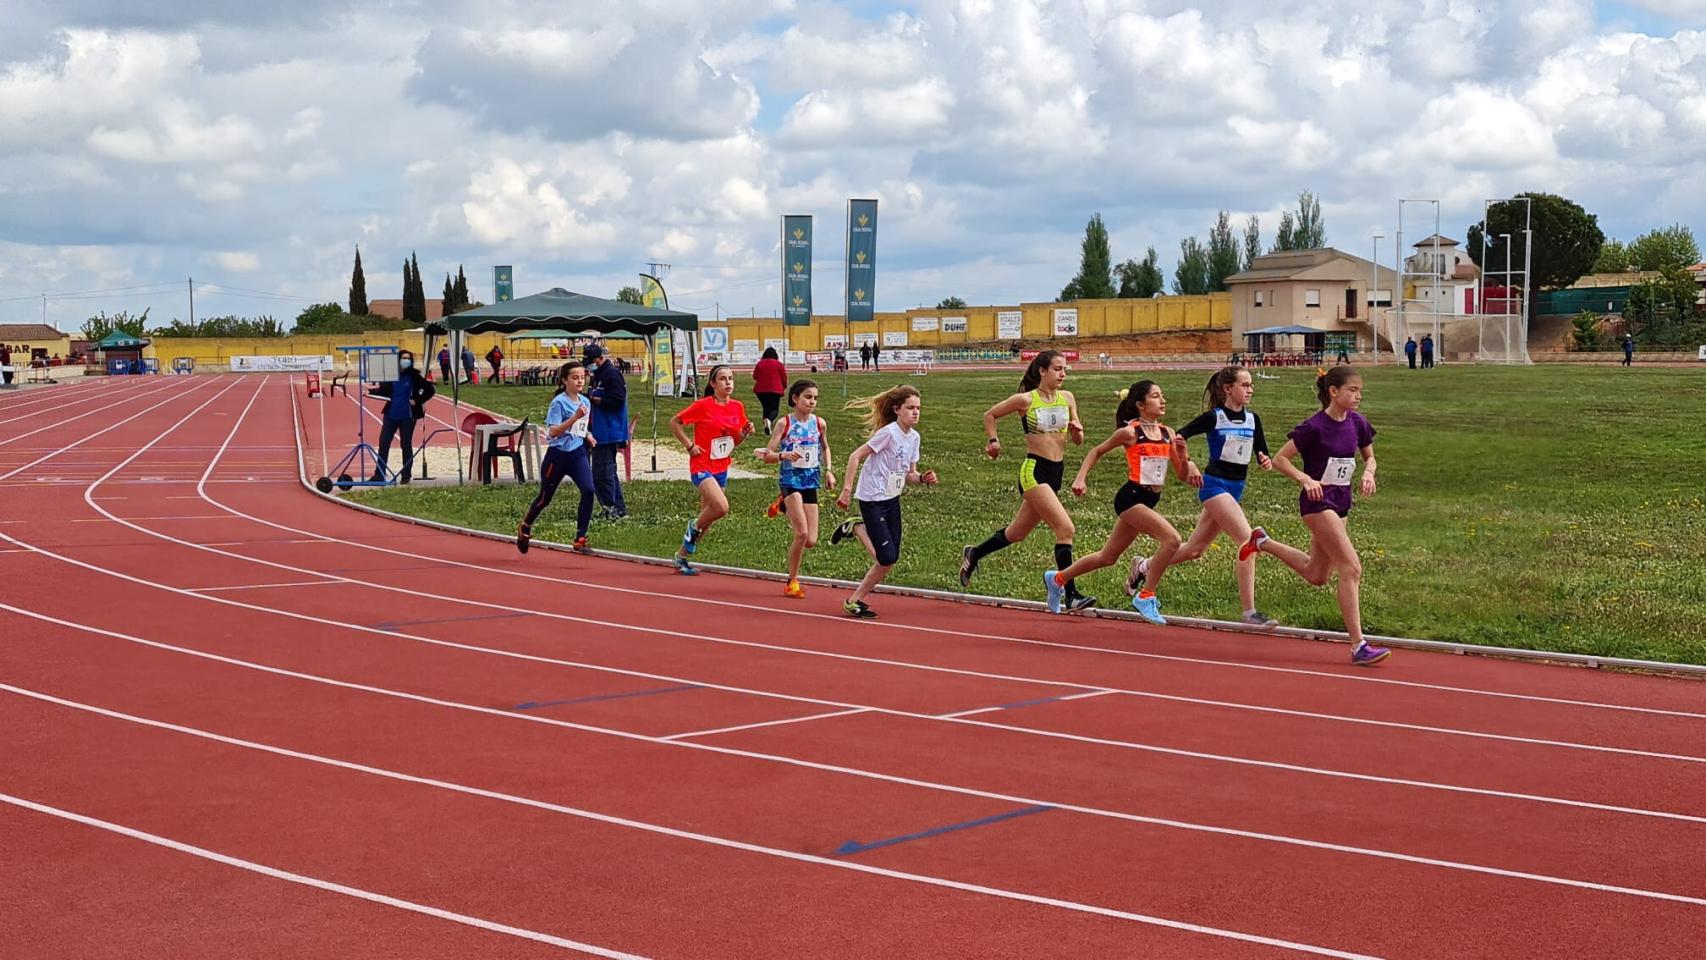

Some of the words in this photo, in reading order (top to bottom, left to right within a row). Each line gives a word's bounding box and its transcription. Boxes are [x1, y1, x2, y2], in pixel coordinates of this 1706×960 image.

[6, 344, 30, 354] BAR
[1051, 414, 1057, 426] 8
[579, 422, 586, 432] 12
[719, 443, 727, 453] 17
[1237, 445, 1243, 456] 4
[805, 452, 810, 462] 9
[1337, 466, 1348, 479] 15
